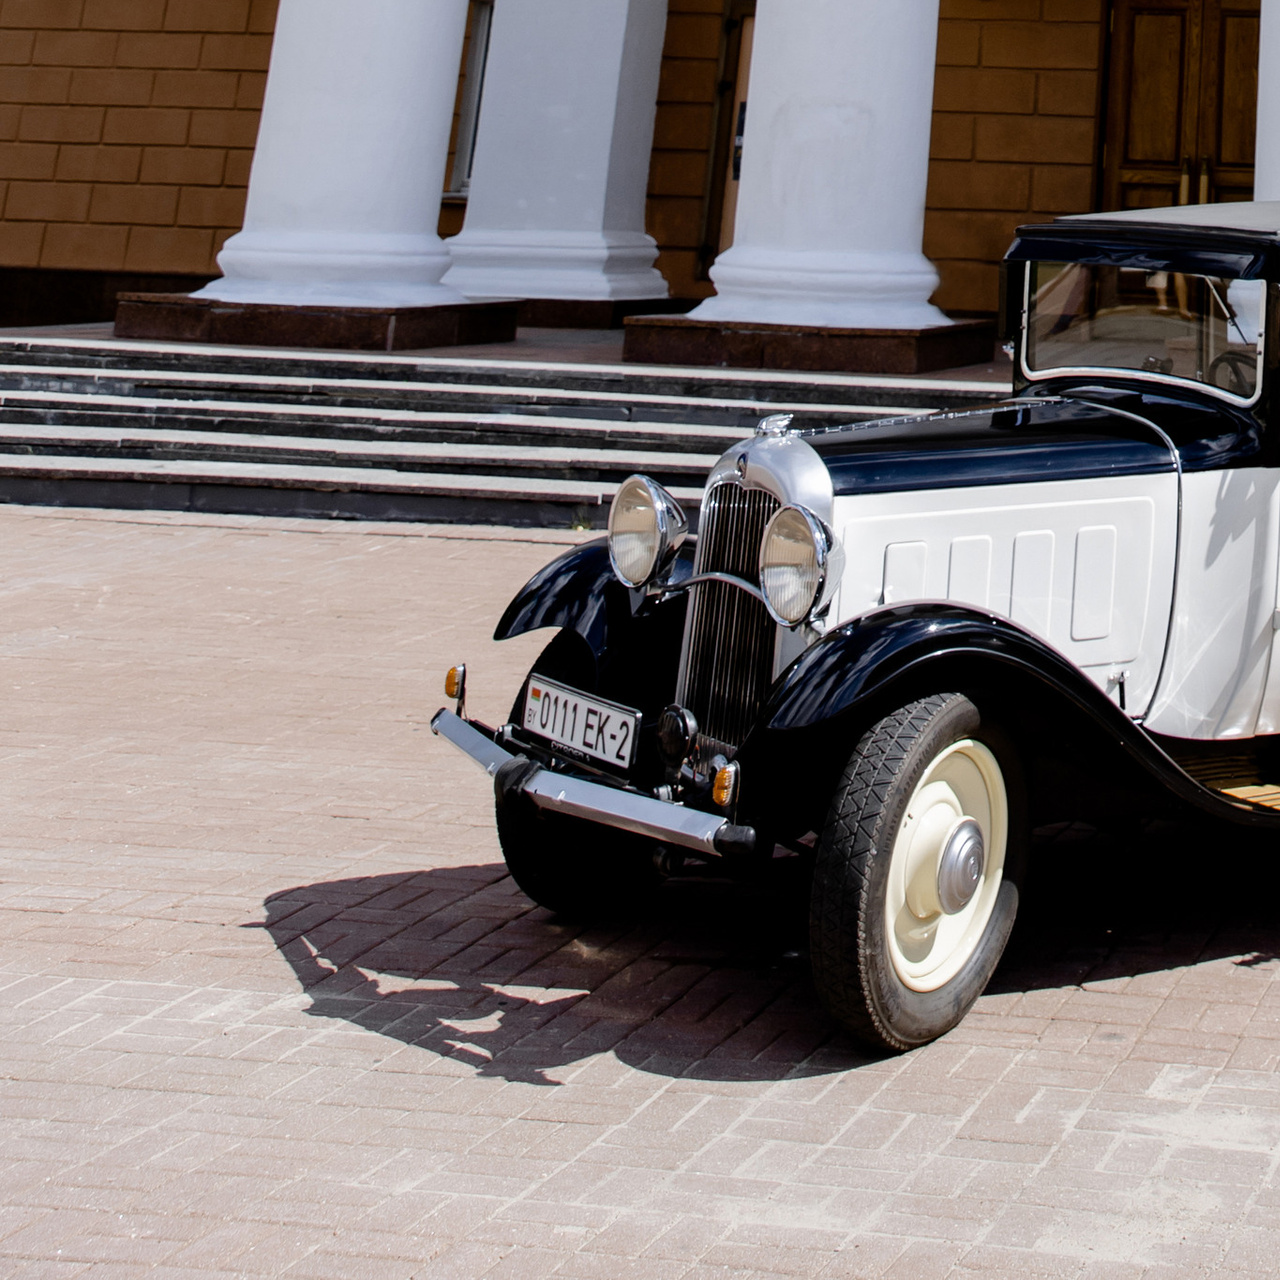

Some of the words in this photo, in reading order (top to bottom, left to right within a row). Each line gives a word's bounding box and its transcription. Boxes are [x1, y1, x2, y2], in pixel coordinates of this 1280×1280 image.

[527, 707, 537, 725] BY
[540, 691, 578, 742] 0111
[583, 707, 630, 761] EK-2
